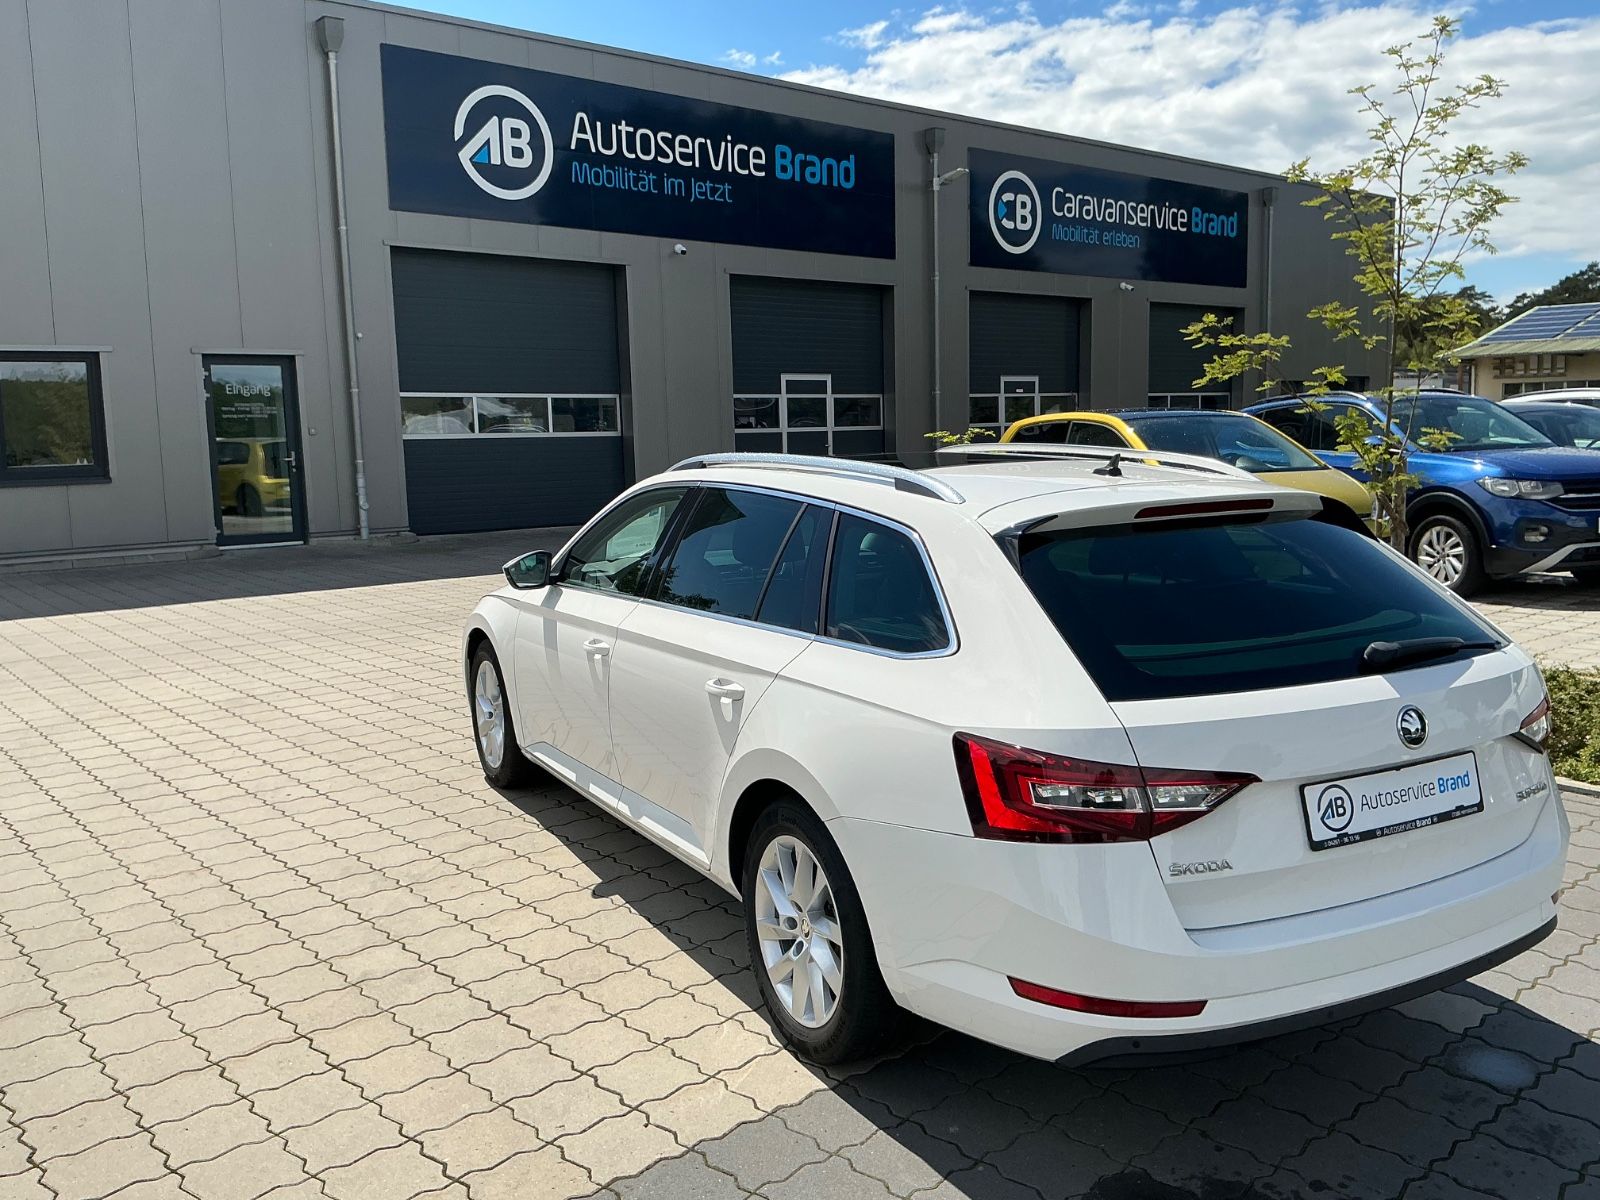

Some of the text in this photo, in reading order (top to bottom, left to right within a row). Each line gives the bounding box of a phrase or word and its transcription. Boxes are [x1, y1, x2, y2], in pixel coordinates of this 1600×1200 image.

[570, 111, 856, 190] Autoservice Brand
[571, 160, 733, 203] Mobilität im Jetzt
[1051, 187, 1238, 238] Caravanservice Brand
[1051, 223, 1140, 249] Mobilität erleben
[225, 383, 271, 397] Eingang
[1360, 780, 1436, 812] Autoservice
[1437, 770, 1471, 794] Brand
[1383, 817, 1432, 836] Autoservice Brand
